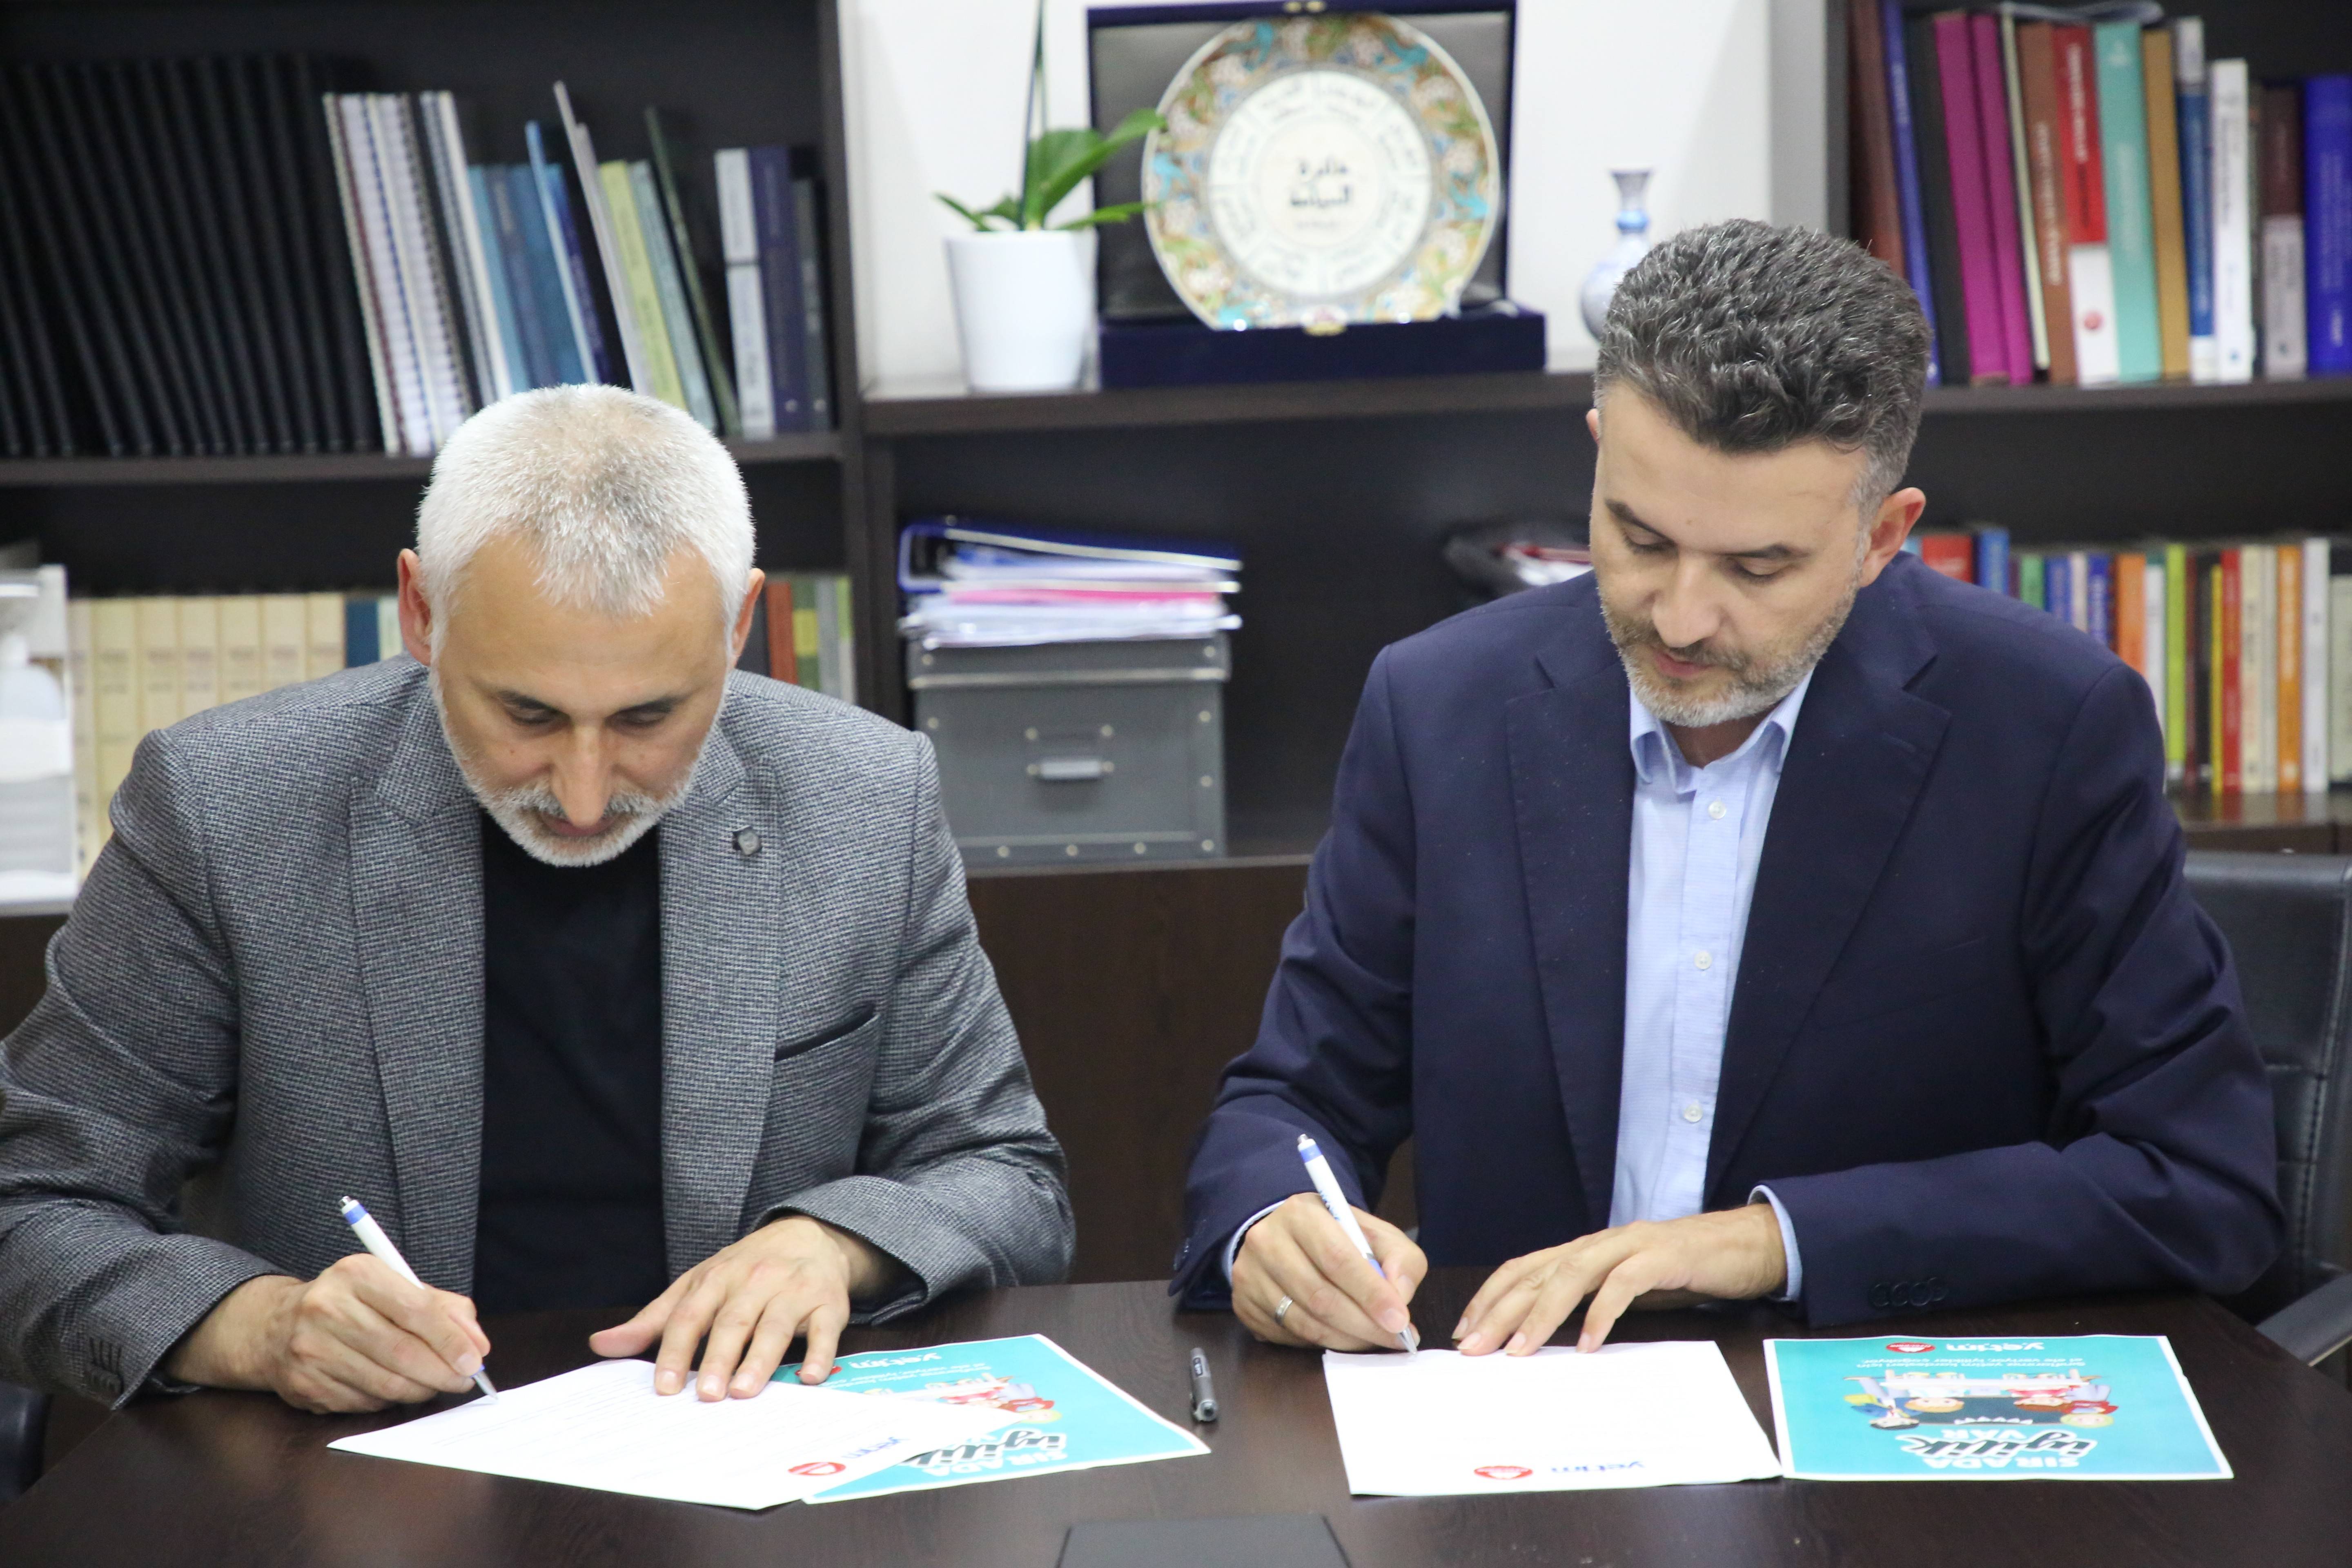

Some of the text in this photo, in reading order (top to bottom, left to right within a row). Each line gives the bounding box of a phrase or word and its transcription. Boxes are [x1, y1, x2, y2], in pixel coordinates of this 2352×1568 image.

[1946, 1342, 2044, 1352] yetim
[848, 1353, 942, 1369] yetim
[1941, 1429, 2027, 1439] VAR
[1903, 1431, 2092, 1457] iyilik
[922, 1451, 1068, 1477] SIRADA
[1551, 1461, 1645, 1473] yetim
[1923, 1457, 2079, 1469] SIRADA
